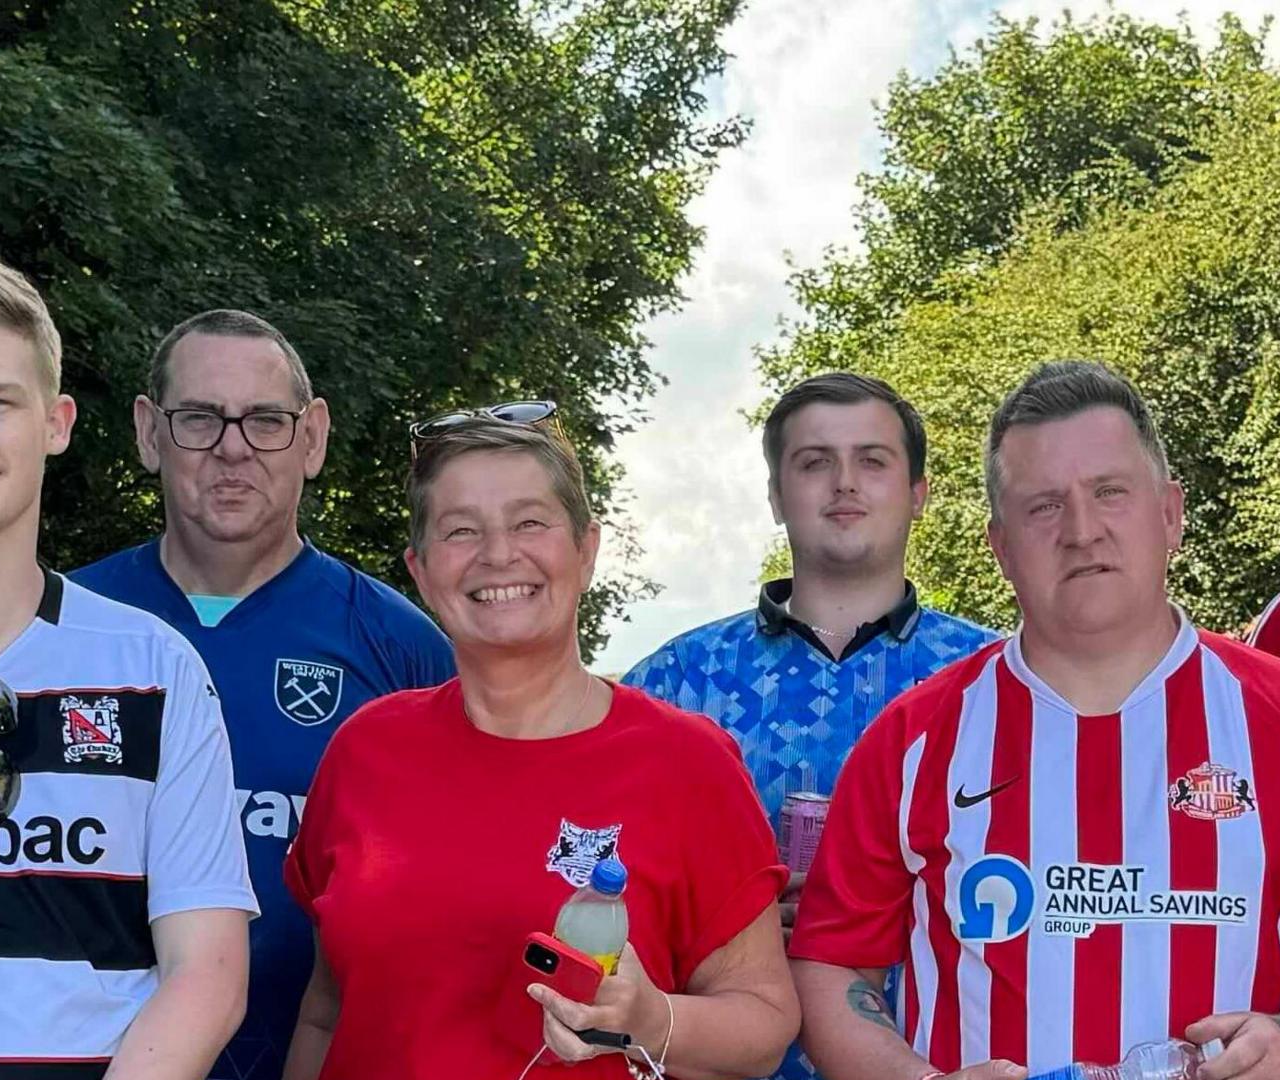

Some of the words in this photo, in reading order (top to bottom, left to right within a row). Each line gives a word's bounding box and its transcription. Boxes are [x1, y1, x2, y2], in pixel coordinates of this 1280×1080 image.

[1046, 865, 1144, 893] GREAT
[1045, 893, 1144, 915] ANNUAL
[1150, 894, 1247, 917] SAVINGS
[1044, 920, 1091, 934] GROUP
